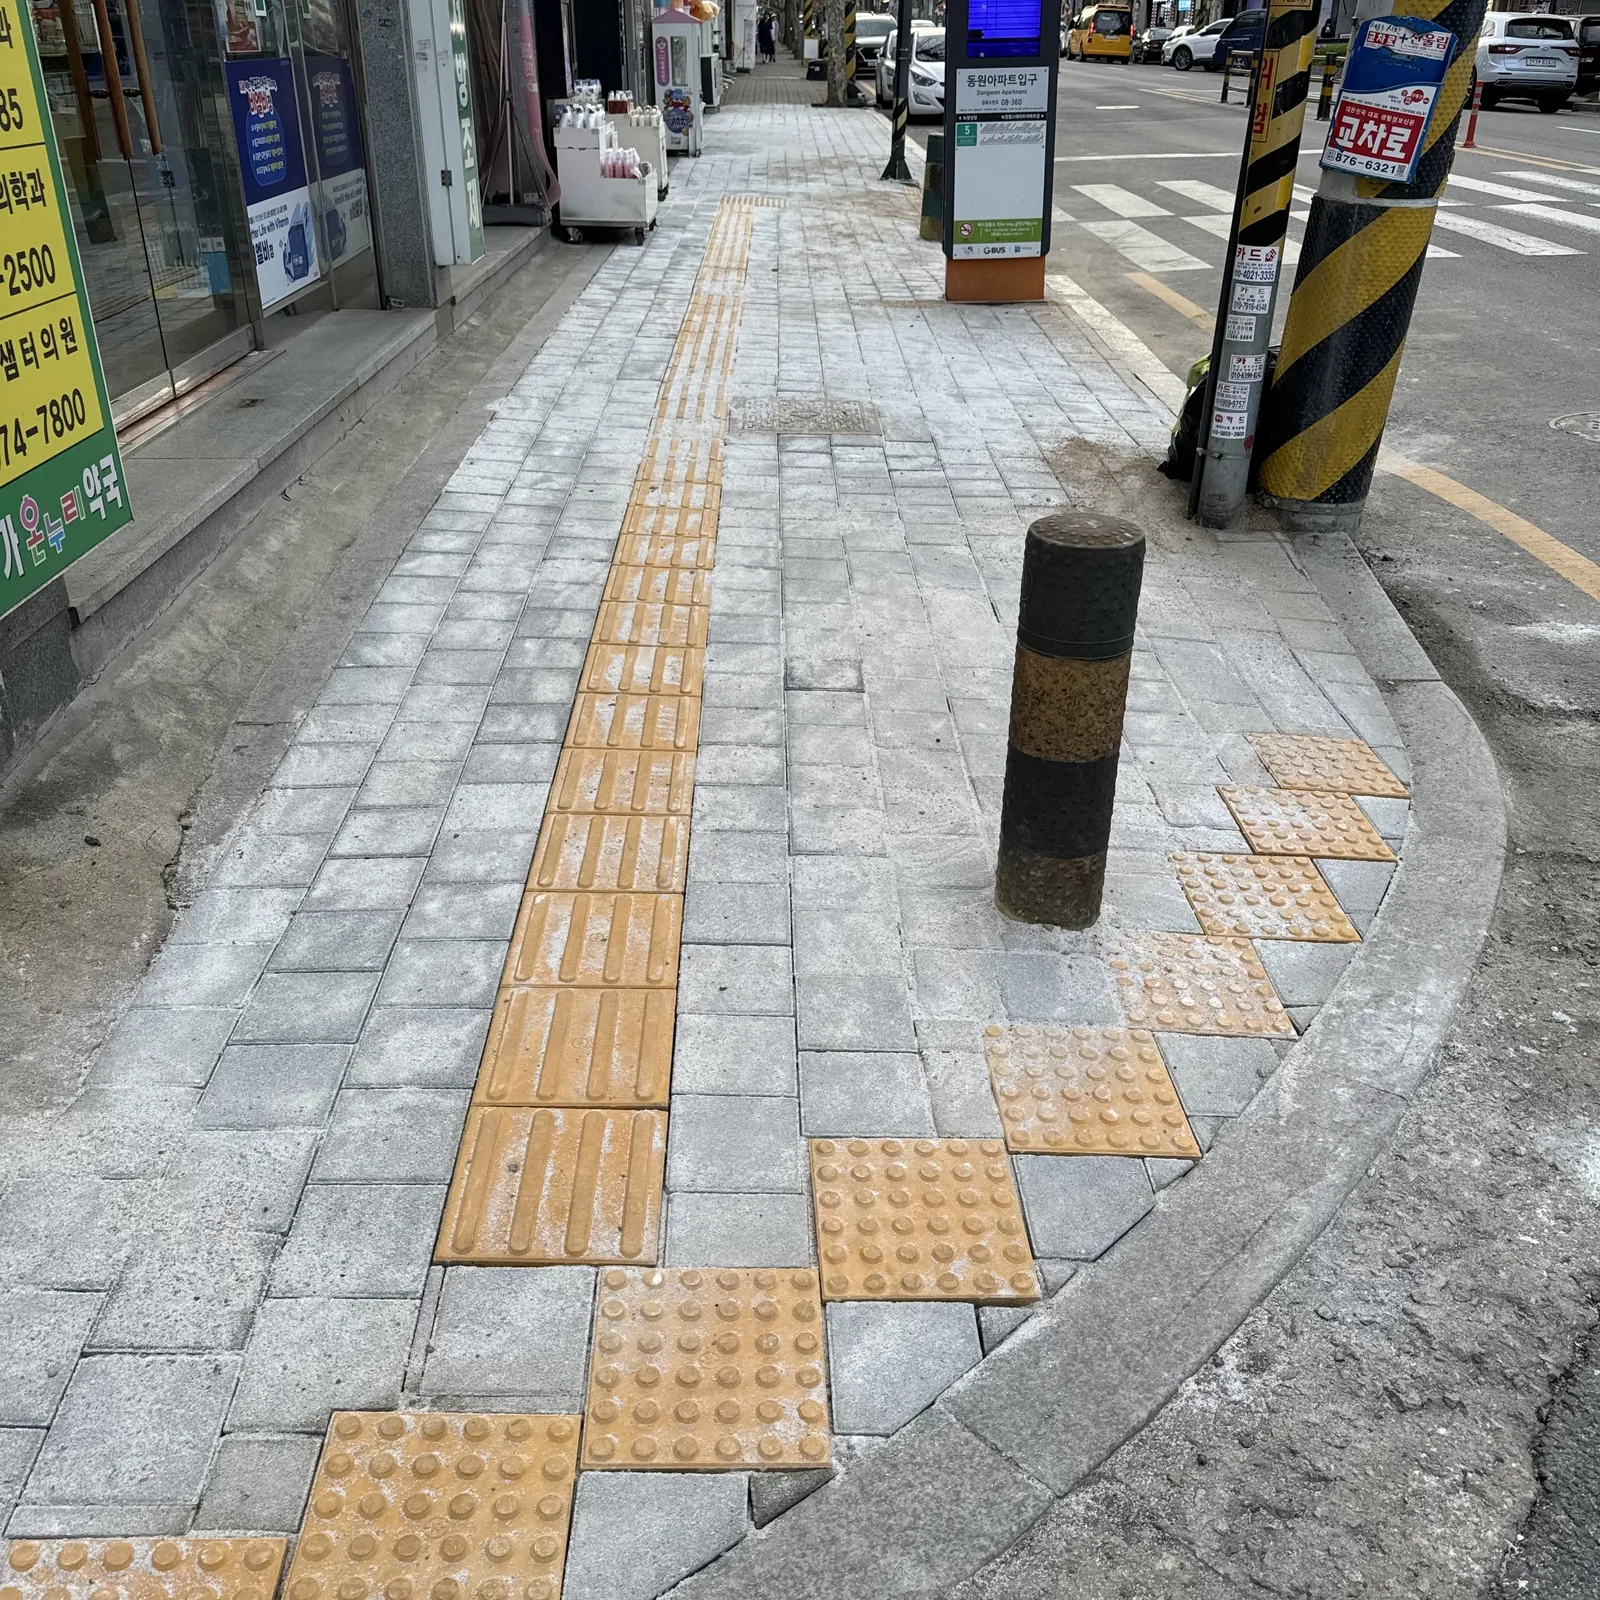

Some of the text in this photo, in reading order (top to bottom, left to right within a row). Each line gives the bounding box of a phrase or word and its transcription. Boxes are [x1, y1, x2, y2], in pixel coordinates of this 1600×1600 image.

[966, 74, 1038, 88] 동원아파트입구
[1000, 98, 1023, 106] 08-360
[964, 125, 971, 135] 5
[1335, 115, 1412, 160] 교차로
[1335, 152, 1396, 175] 876-6321
[1236, 247, 1261, 261] 카드
